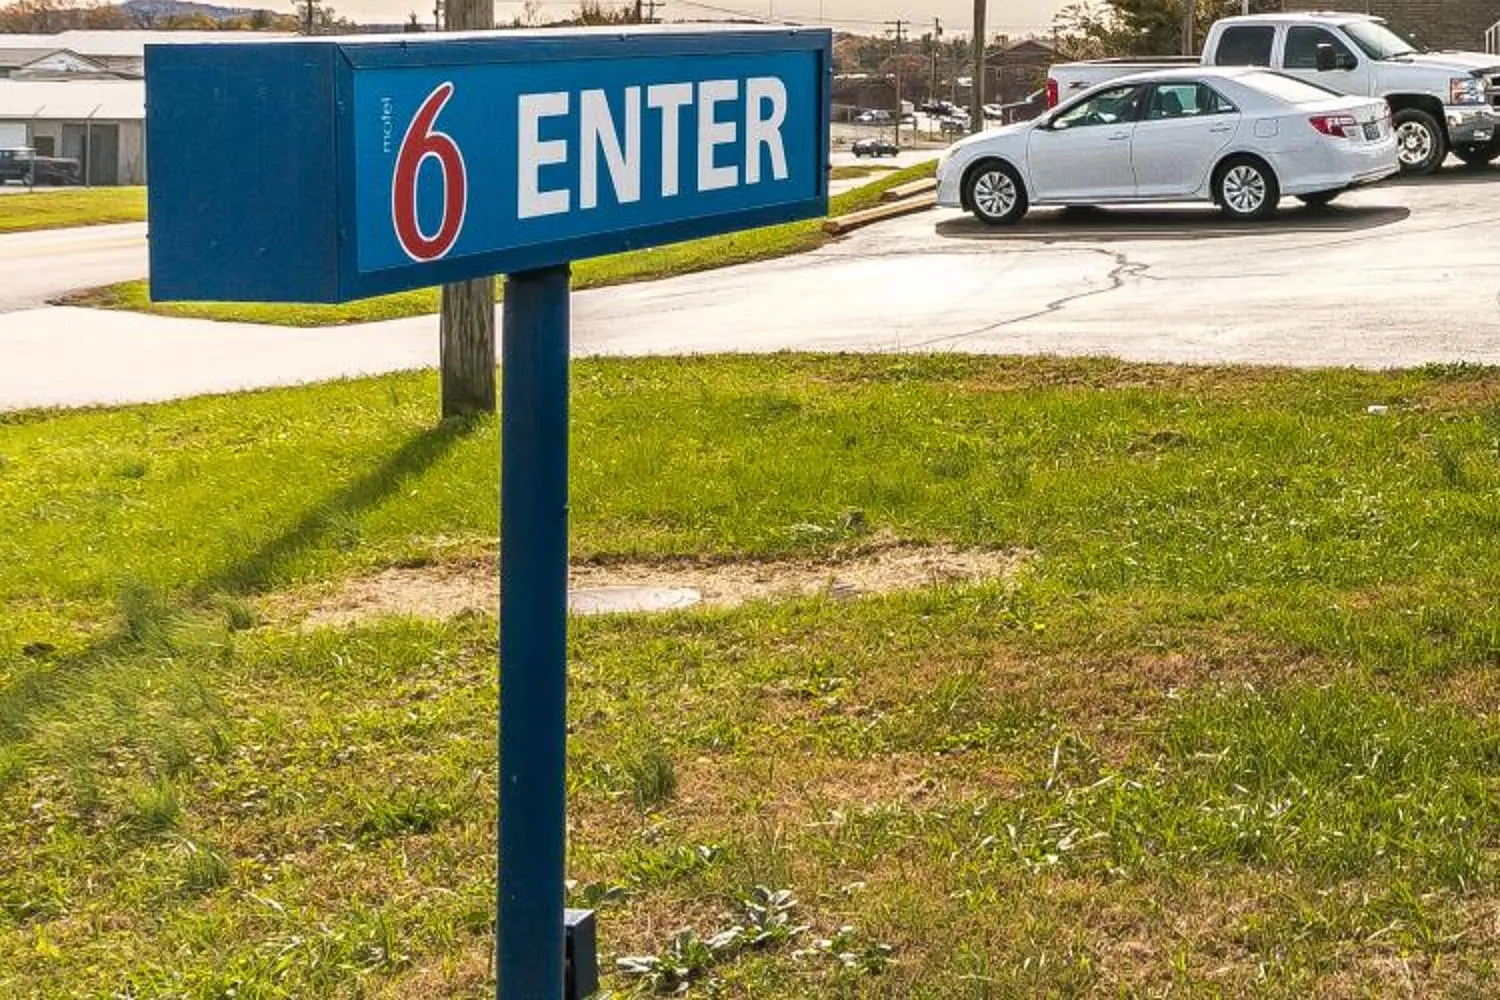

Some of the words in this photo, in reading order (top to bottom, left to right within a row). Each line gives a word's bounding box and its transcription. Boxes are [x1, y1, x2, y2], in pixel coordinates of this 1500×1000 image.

[380, 97, 393, 153] motel
[391, 81, 468, 262] 6
[518, 76, 788, 219] ENTER
